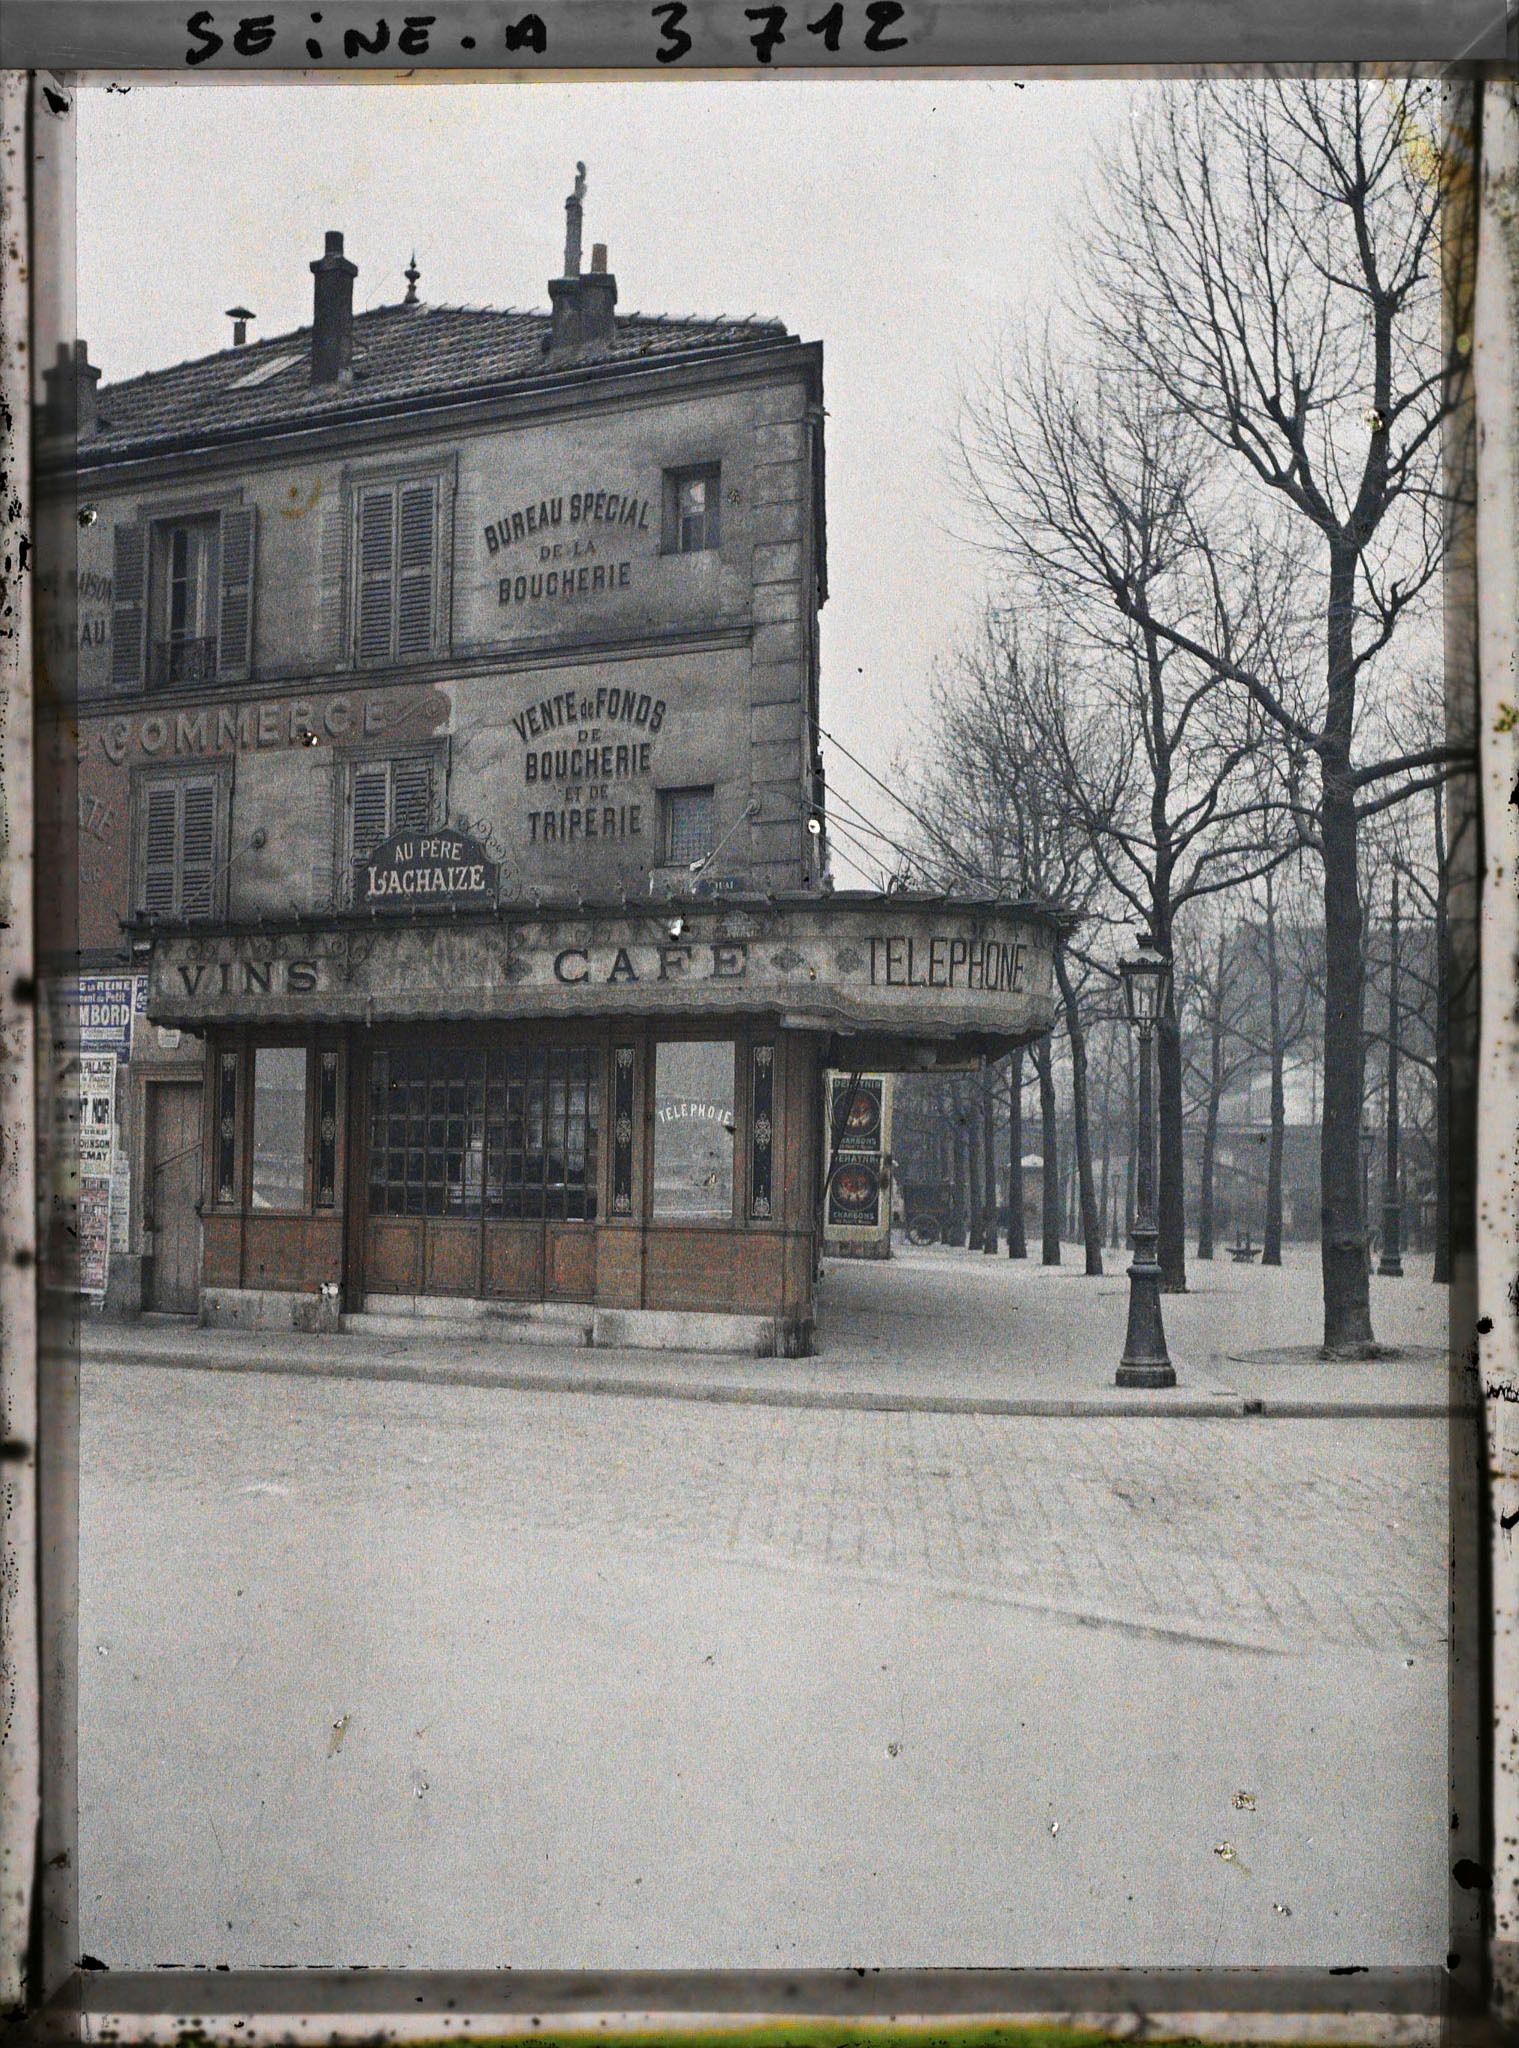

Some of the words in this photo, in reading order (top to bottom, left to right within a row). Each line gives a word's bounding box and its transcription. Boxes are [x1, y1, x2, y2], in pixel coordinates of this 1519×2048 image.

[484, 497, 562, 554] BUREAU
[540, 544, 562, 561] DE
[573, 540, 597, 556] LA
[499, 562, 631, 606] BOUCHERIE
[98, 697, 386, 766] COMMERCE
[512, 691, 577, 742] VENTE
[580, 697, 594, 720] de
[596, 688, 666, 733] FONDS
[577, 728, 601, 743] DE
[526, 742, 651, 781] BOUCHERIE
[565, 786, 582, 802] ET
[589, 785, 608, 800] DE
[528, 805, 641, 842] TRIPERIE
[395, 842, 413, 862] AU
[367, 864, 485, 896] LACHAIZE
[178, 961, 318, 997] VINS
[864, 936, 1027, 992] TELEPHONE
[96, 980, 132, 991] REINE
